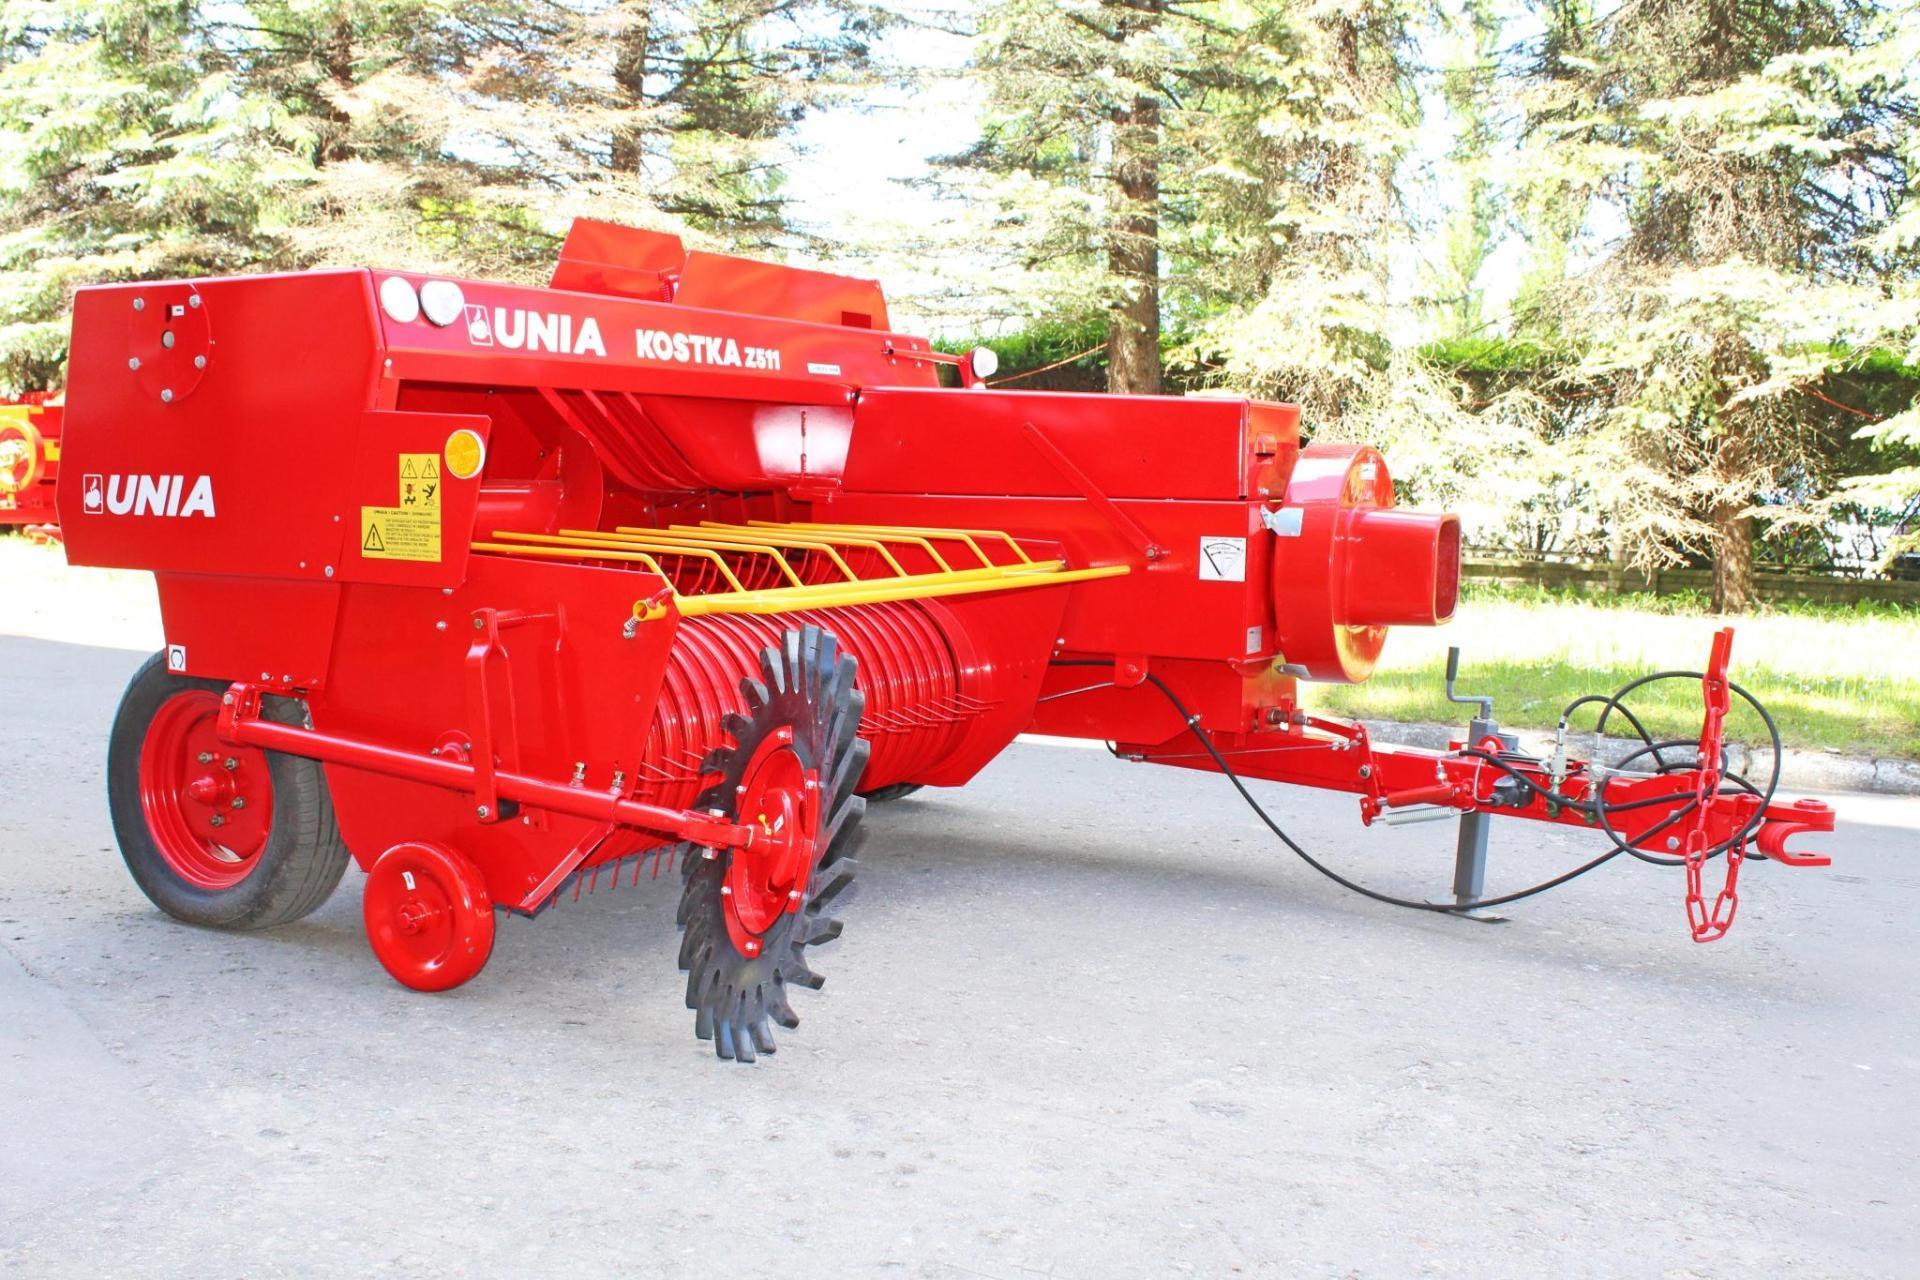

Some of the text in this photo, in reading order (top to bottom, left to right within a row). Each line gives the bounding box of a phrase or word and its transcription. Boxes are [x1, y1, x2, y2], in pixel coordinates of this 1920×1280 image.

[494, 307, 607, 357] UNIA
[636, 329, 781, 370] KOSTKA Z511
[106, 474, 216, 518] UNIA
